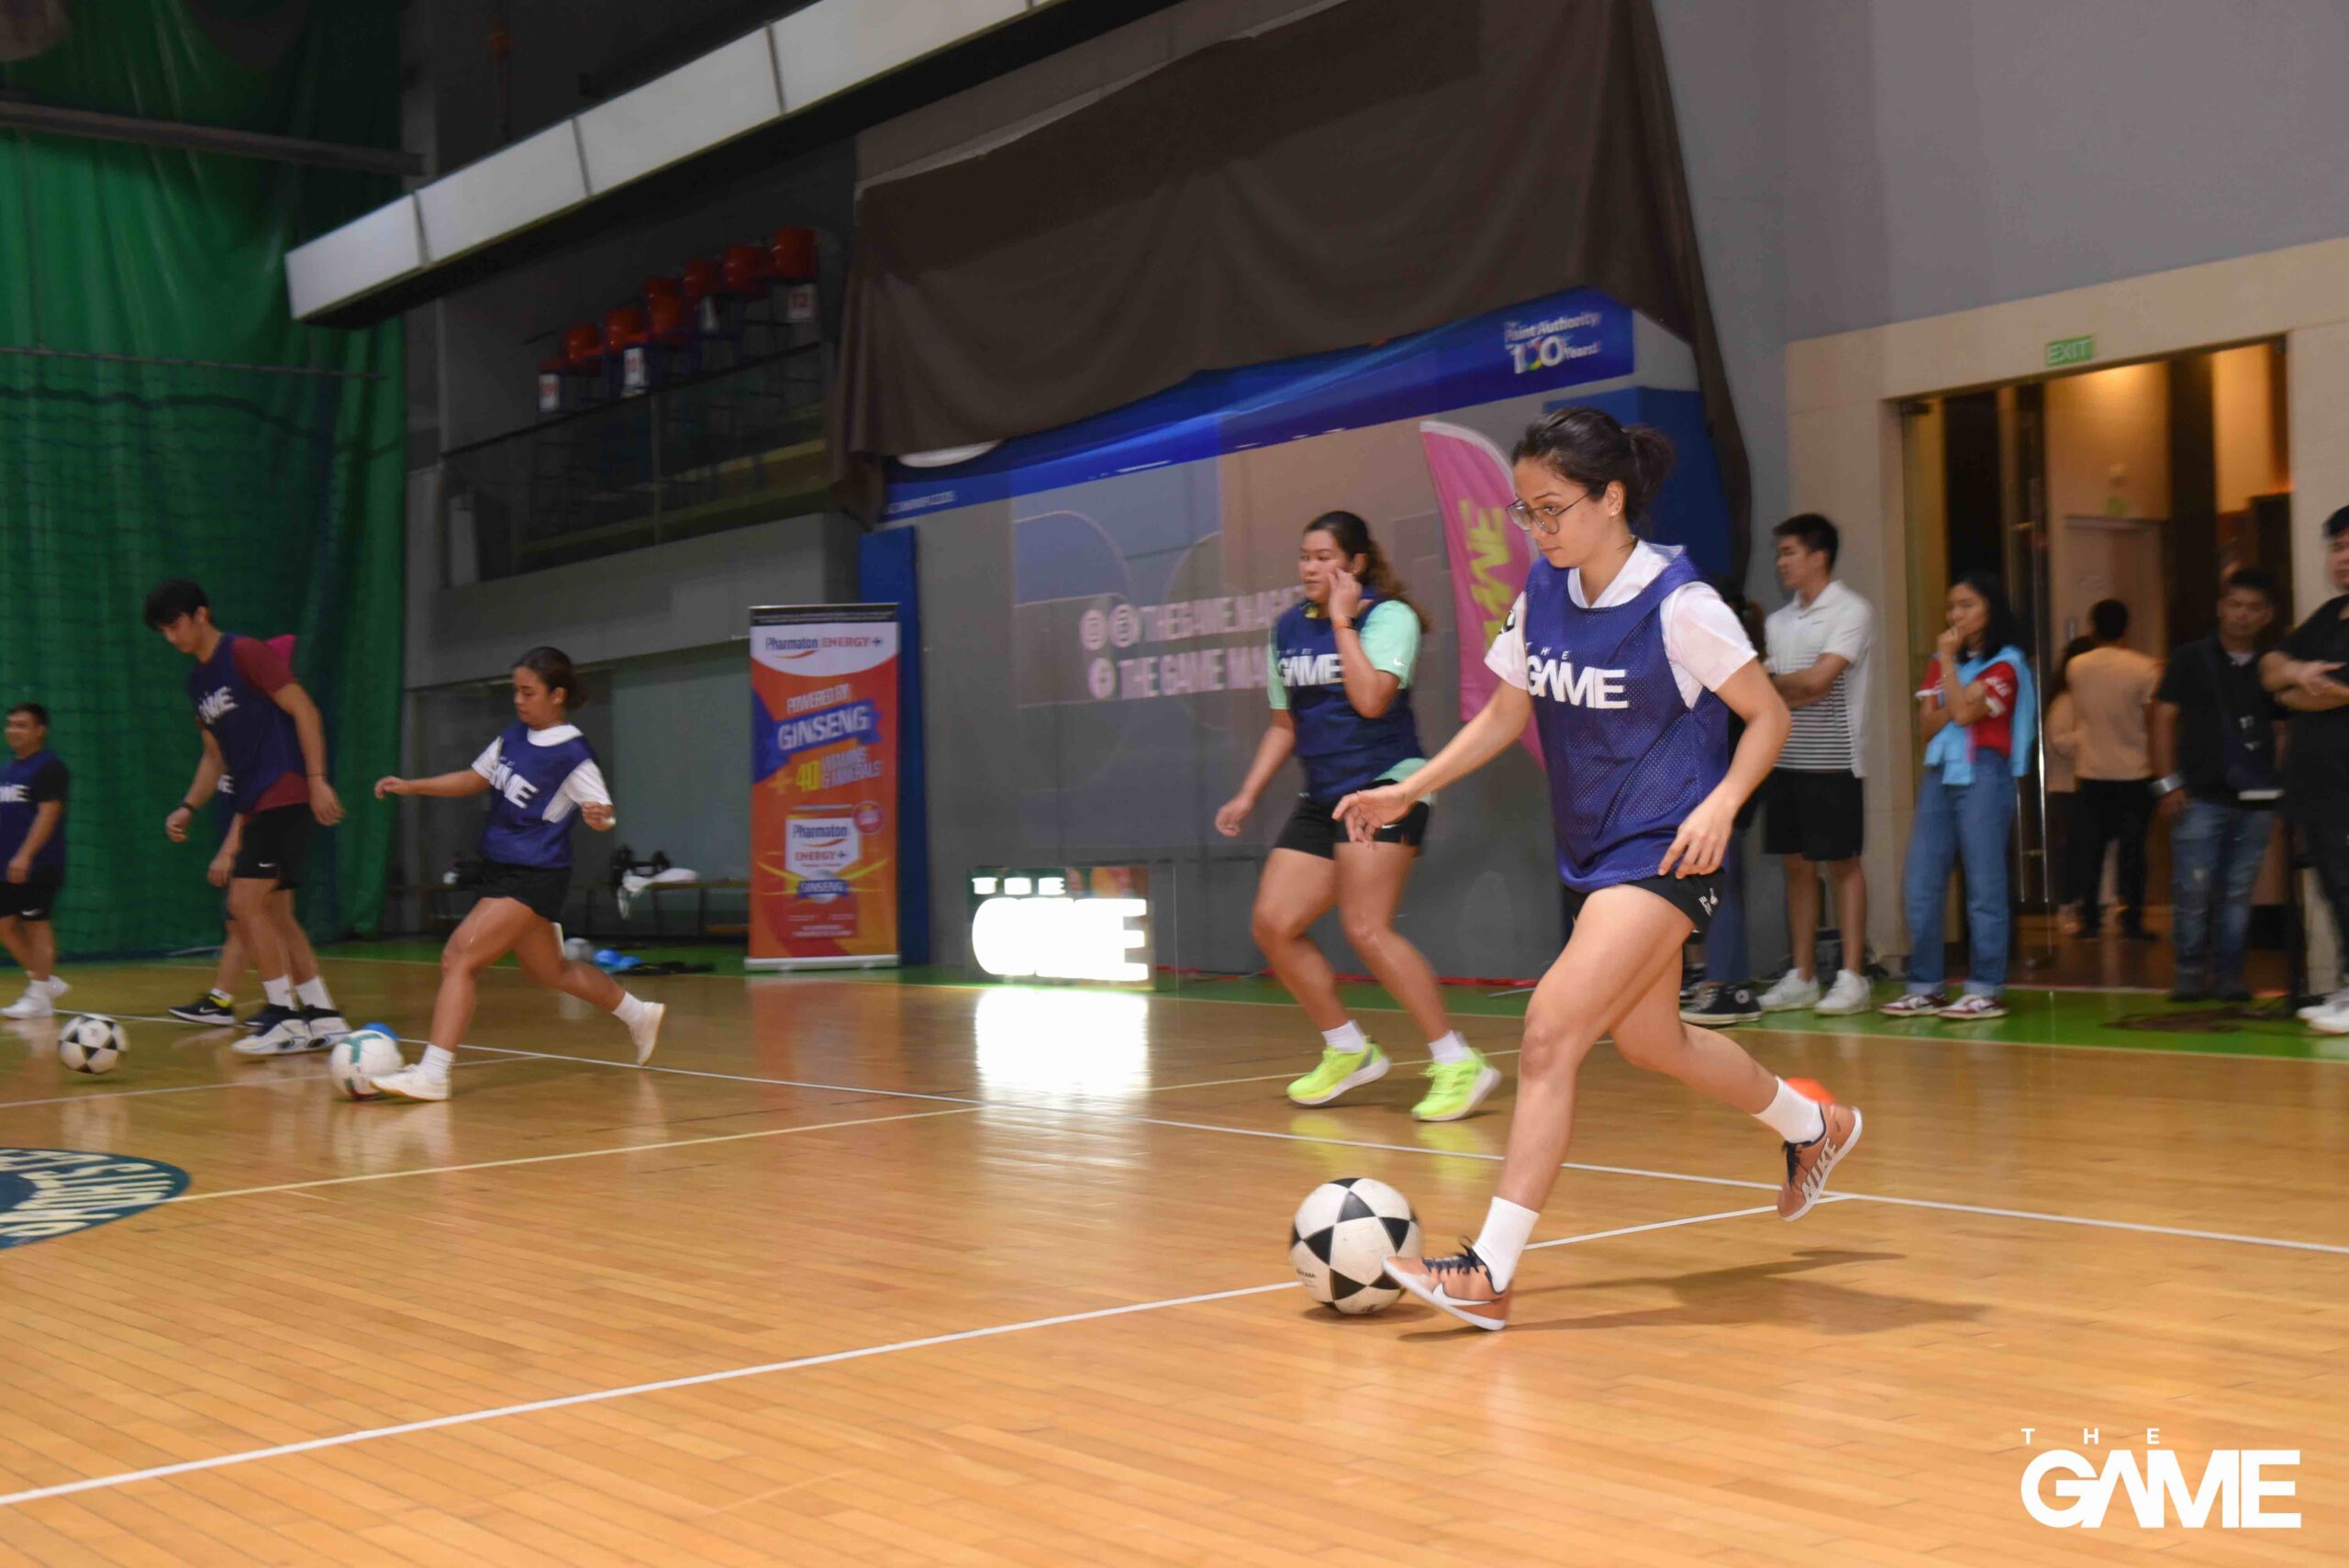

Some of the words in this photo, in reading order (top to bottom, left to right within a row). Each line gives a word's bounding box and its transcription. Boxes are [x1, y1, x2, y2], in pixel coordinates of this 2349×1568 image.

[1537, 311, 1601, 336] Authority
[2047, 339, 2091, 363] EXIT
[765, 637, 818, 651] Pharmaton
[1117, 656, 1159, 700] THE
[1160, 648, 1225, 695] GAME
[1278, 653, 1343, 686] GAME
[1527, 654, 1630, 709] GAME
[778, 705, 871, 751] GINSENG
[795, 760, 819, 793] 40
[793, 825, 848, 839] Pharmaton
[1801, 1137, 1837, 1203] NIKE
